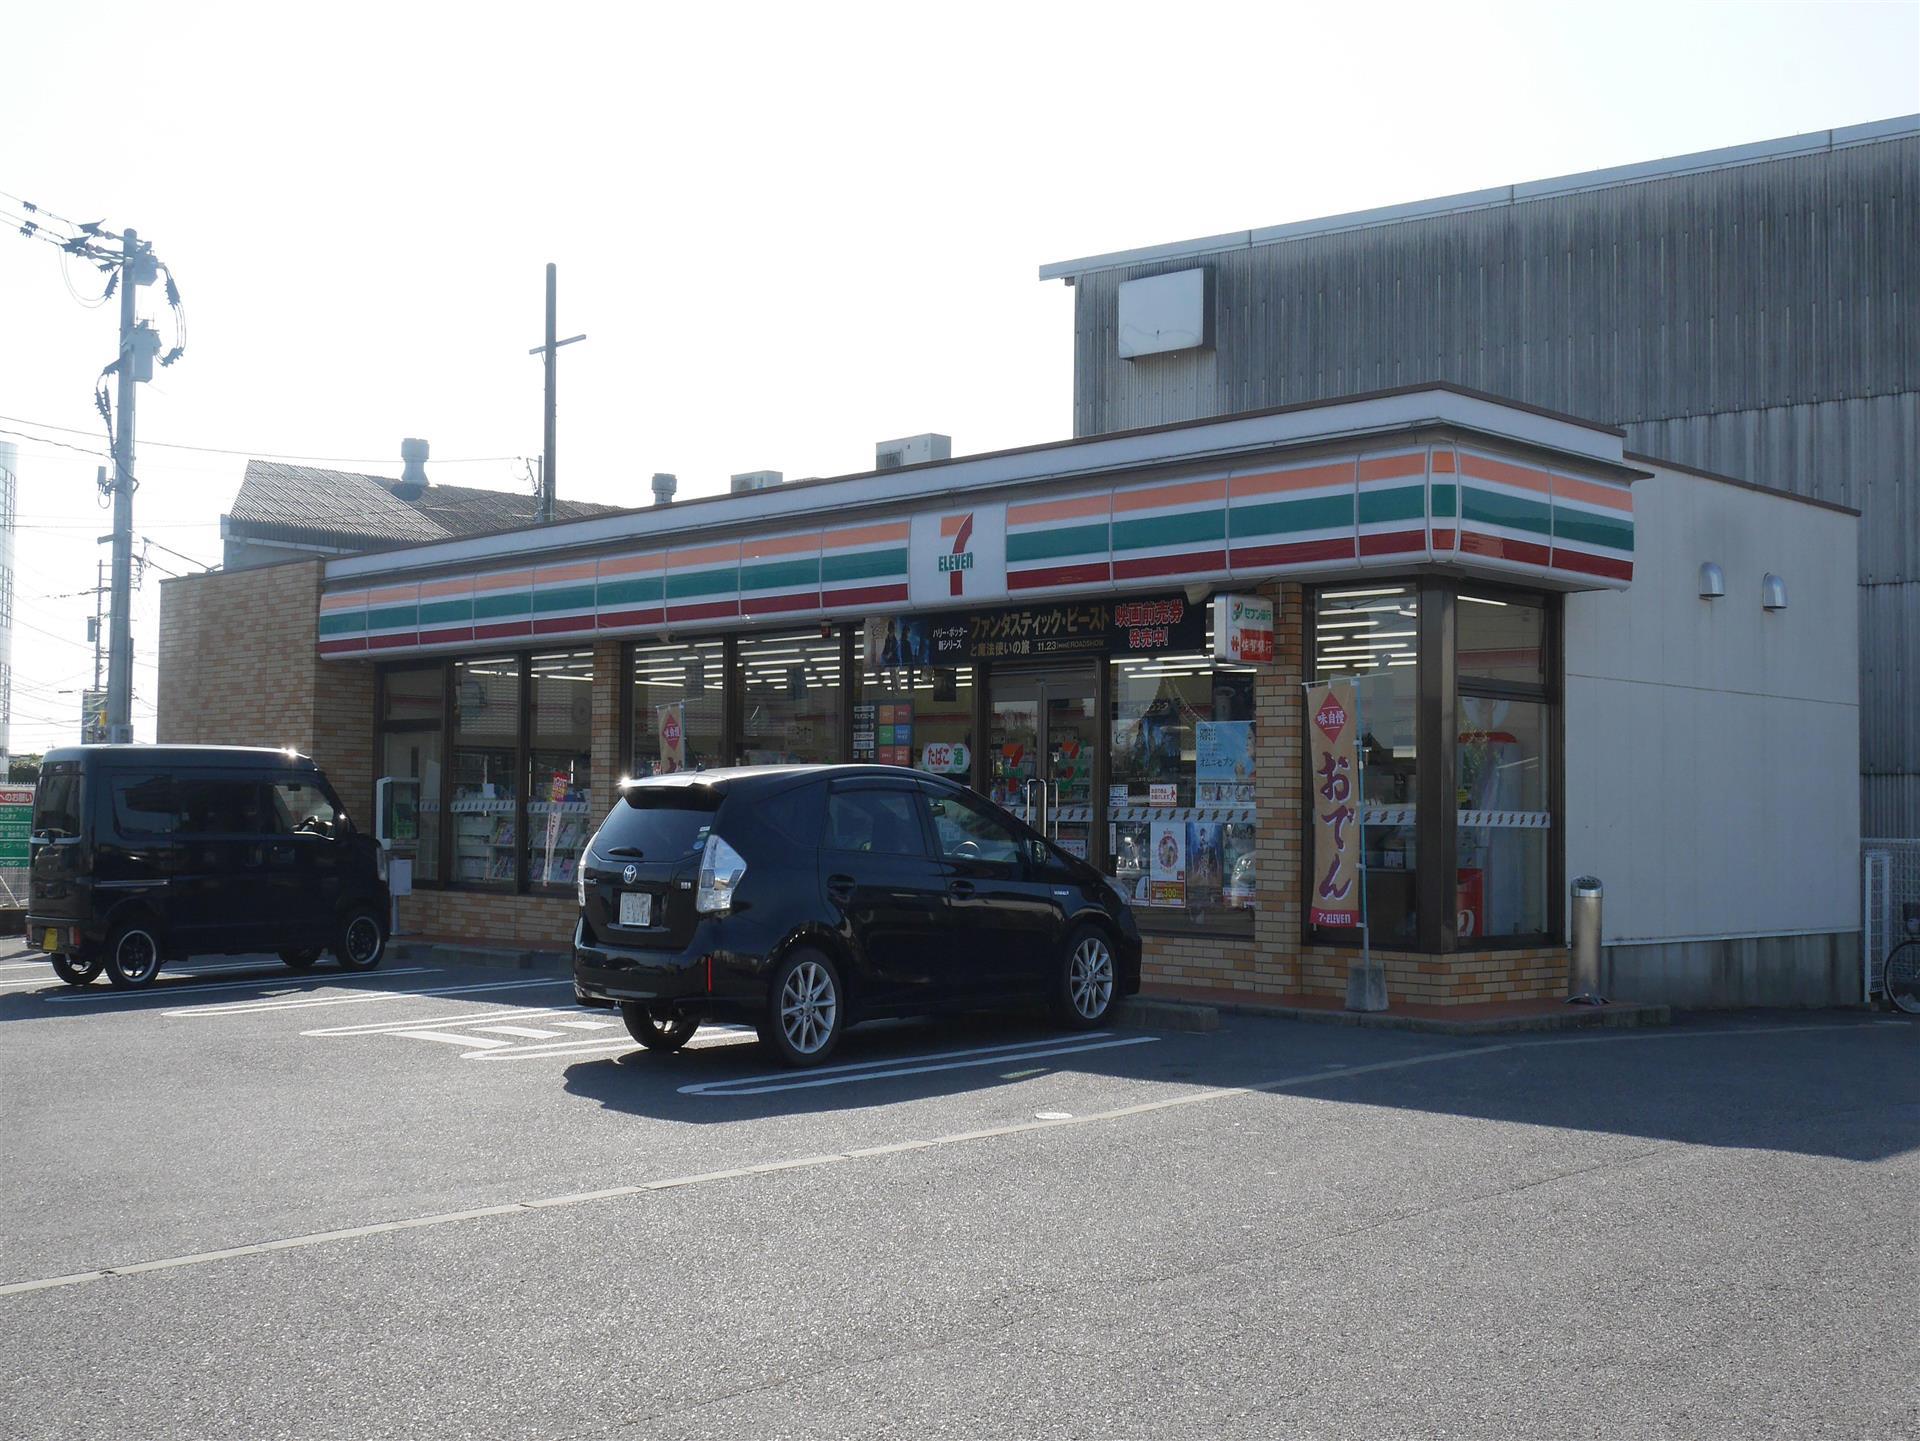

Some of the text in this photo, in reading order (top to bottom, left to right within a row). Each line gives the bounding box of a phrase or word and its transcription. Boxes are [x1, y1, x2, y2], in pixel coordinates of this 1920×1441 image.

[1115, 600, 1184, 628] 映画前売券
[1317, 711, 1346, 726] 味自慢
[1317, 751, 1355, 900] おでん
